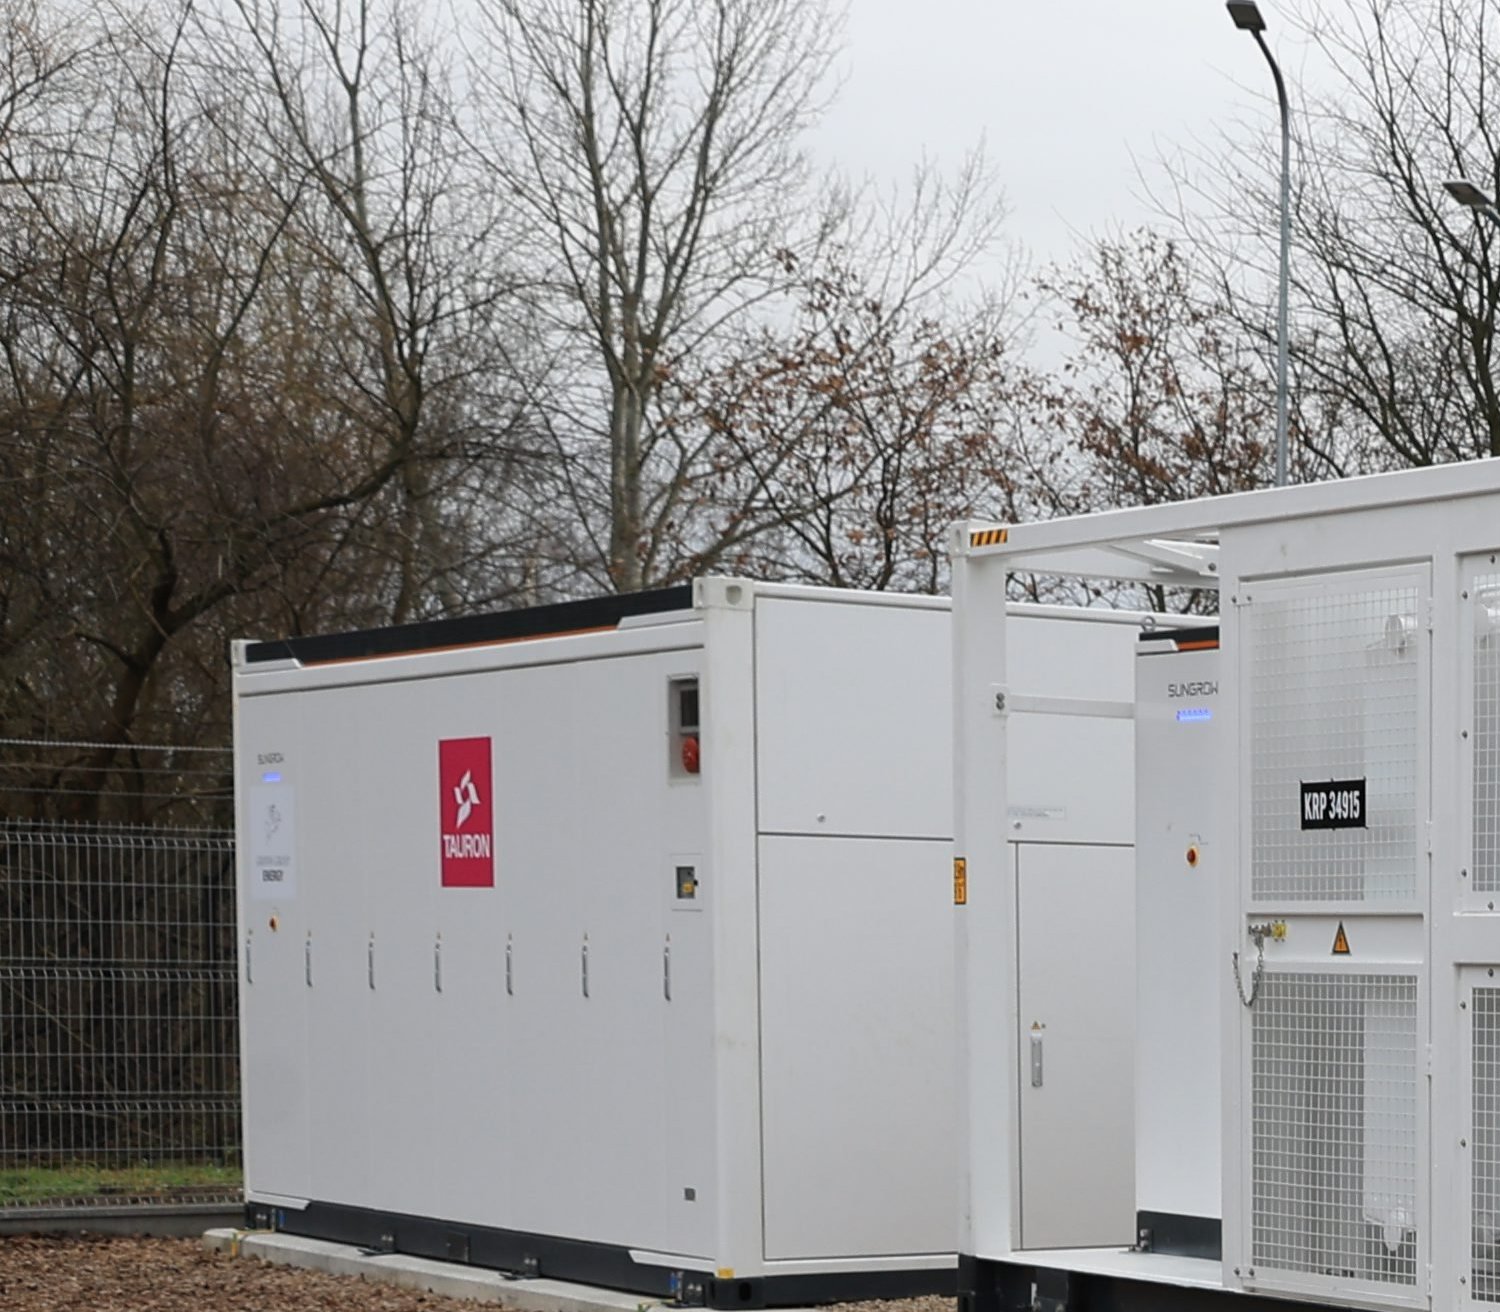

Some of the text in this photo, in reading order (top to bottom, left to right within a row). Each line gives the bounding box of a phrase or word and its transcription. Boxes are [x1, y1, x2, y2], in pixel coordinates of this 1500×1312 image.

[1168, 681, 1218, 698] SUNGROW
[1304, 789, 1360, 820] KRP 34915
[443, 834, 490, 859] TAURON
